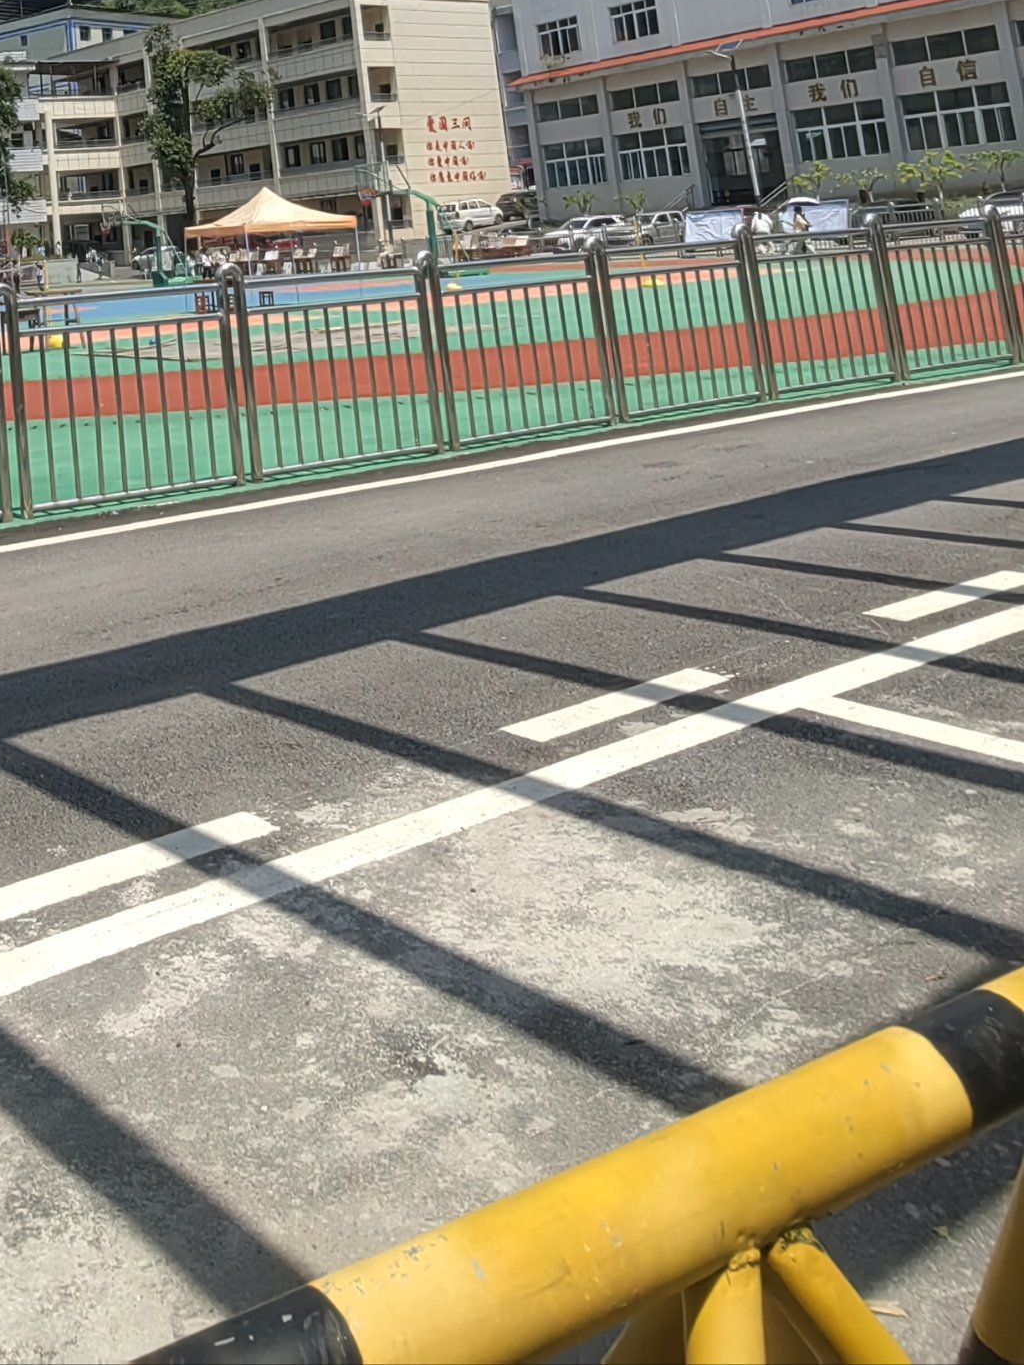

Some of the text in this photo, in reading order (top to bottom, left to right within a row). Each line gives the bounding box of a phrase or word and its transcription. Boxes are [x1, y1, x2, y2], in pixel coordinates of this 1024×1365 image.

[628, 59, 979, 129] 我们 自主 我们 自信
